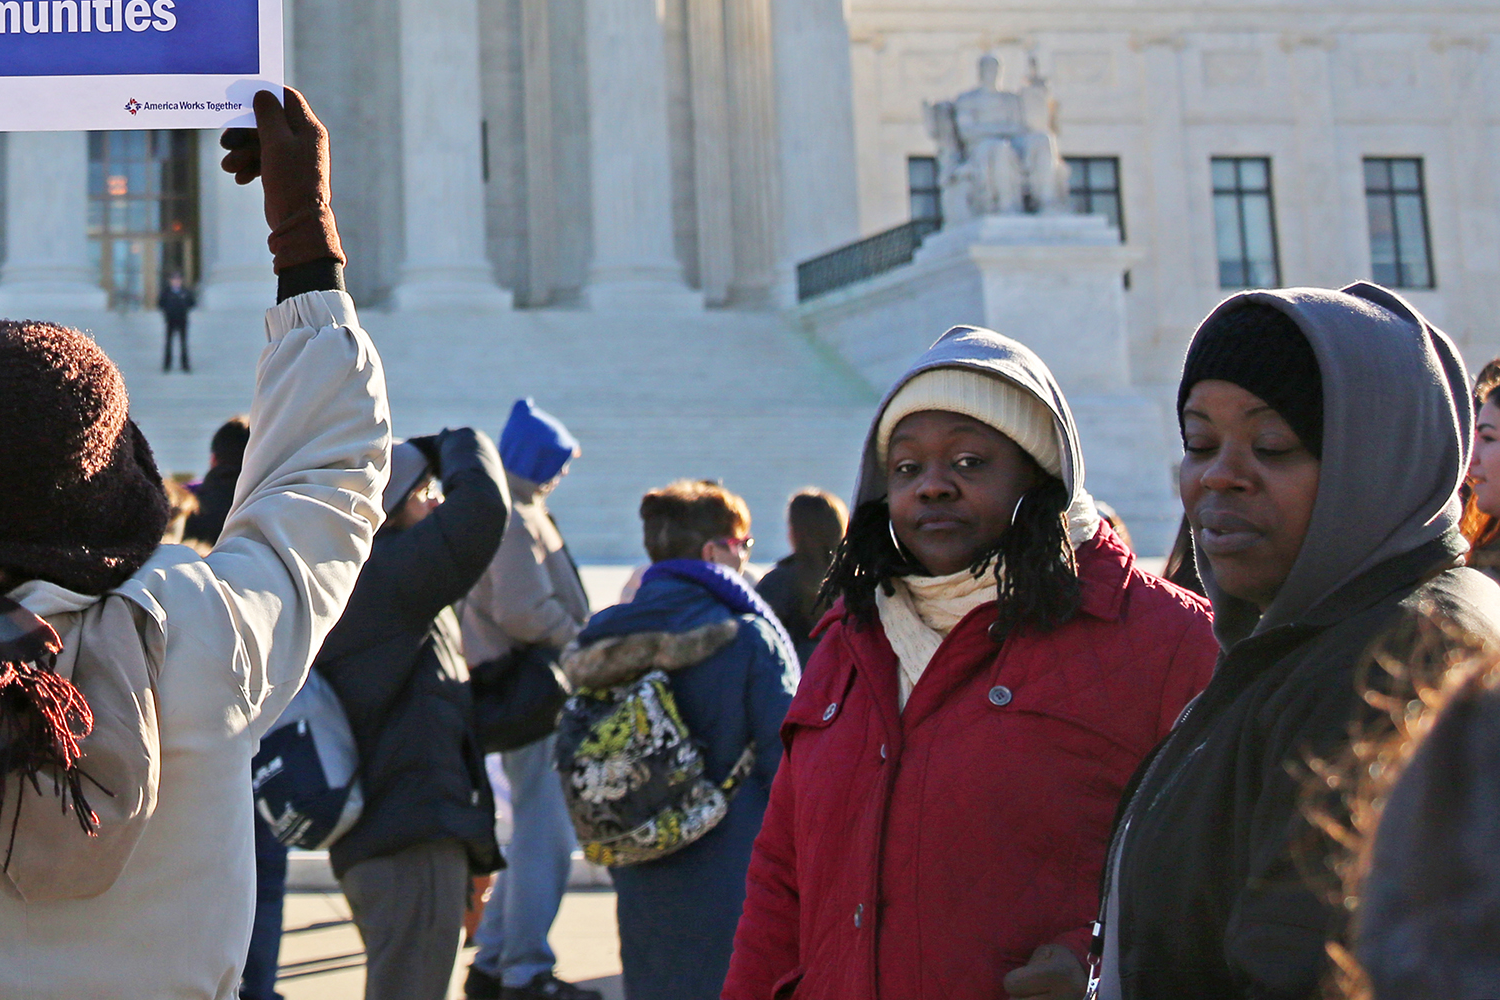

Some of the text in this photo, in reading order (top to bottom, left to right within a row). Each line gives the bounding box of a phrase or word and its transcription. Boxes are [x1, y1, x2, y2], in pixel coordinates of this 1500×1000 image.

[143, 101, 243, 113] America Works Together
